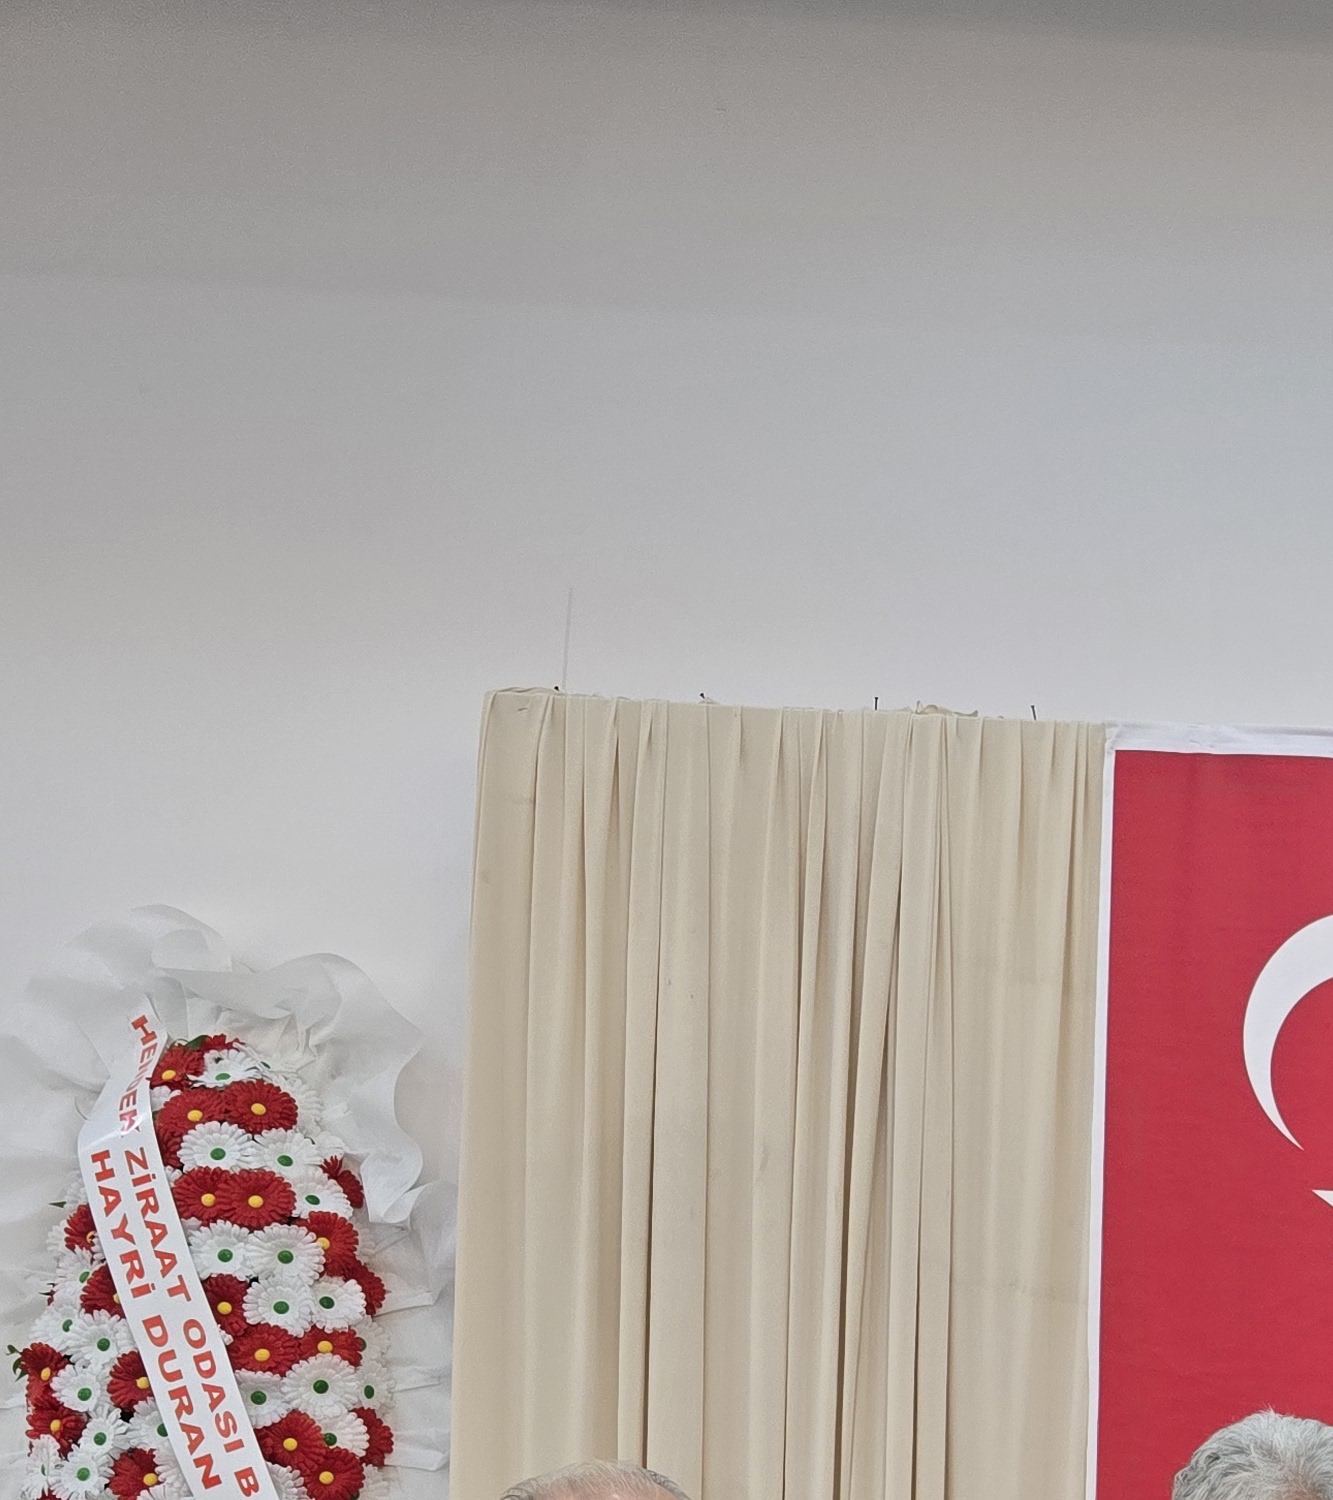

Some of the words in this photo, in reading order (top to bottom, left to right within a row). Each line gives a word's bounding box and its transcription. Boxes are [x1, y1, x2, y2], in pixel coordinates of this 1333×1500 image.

[91, 1149, 156, 1299] HAYRİ
[142, 1314, 222, 1490] DURAN
[124, 1147, 192, 1302] ZİRAAT
[182, 1318, 245, 1453] ODASI
